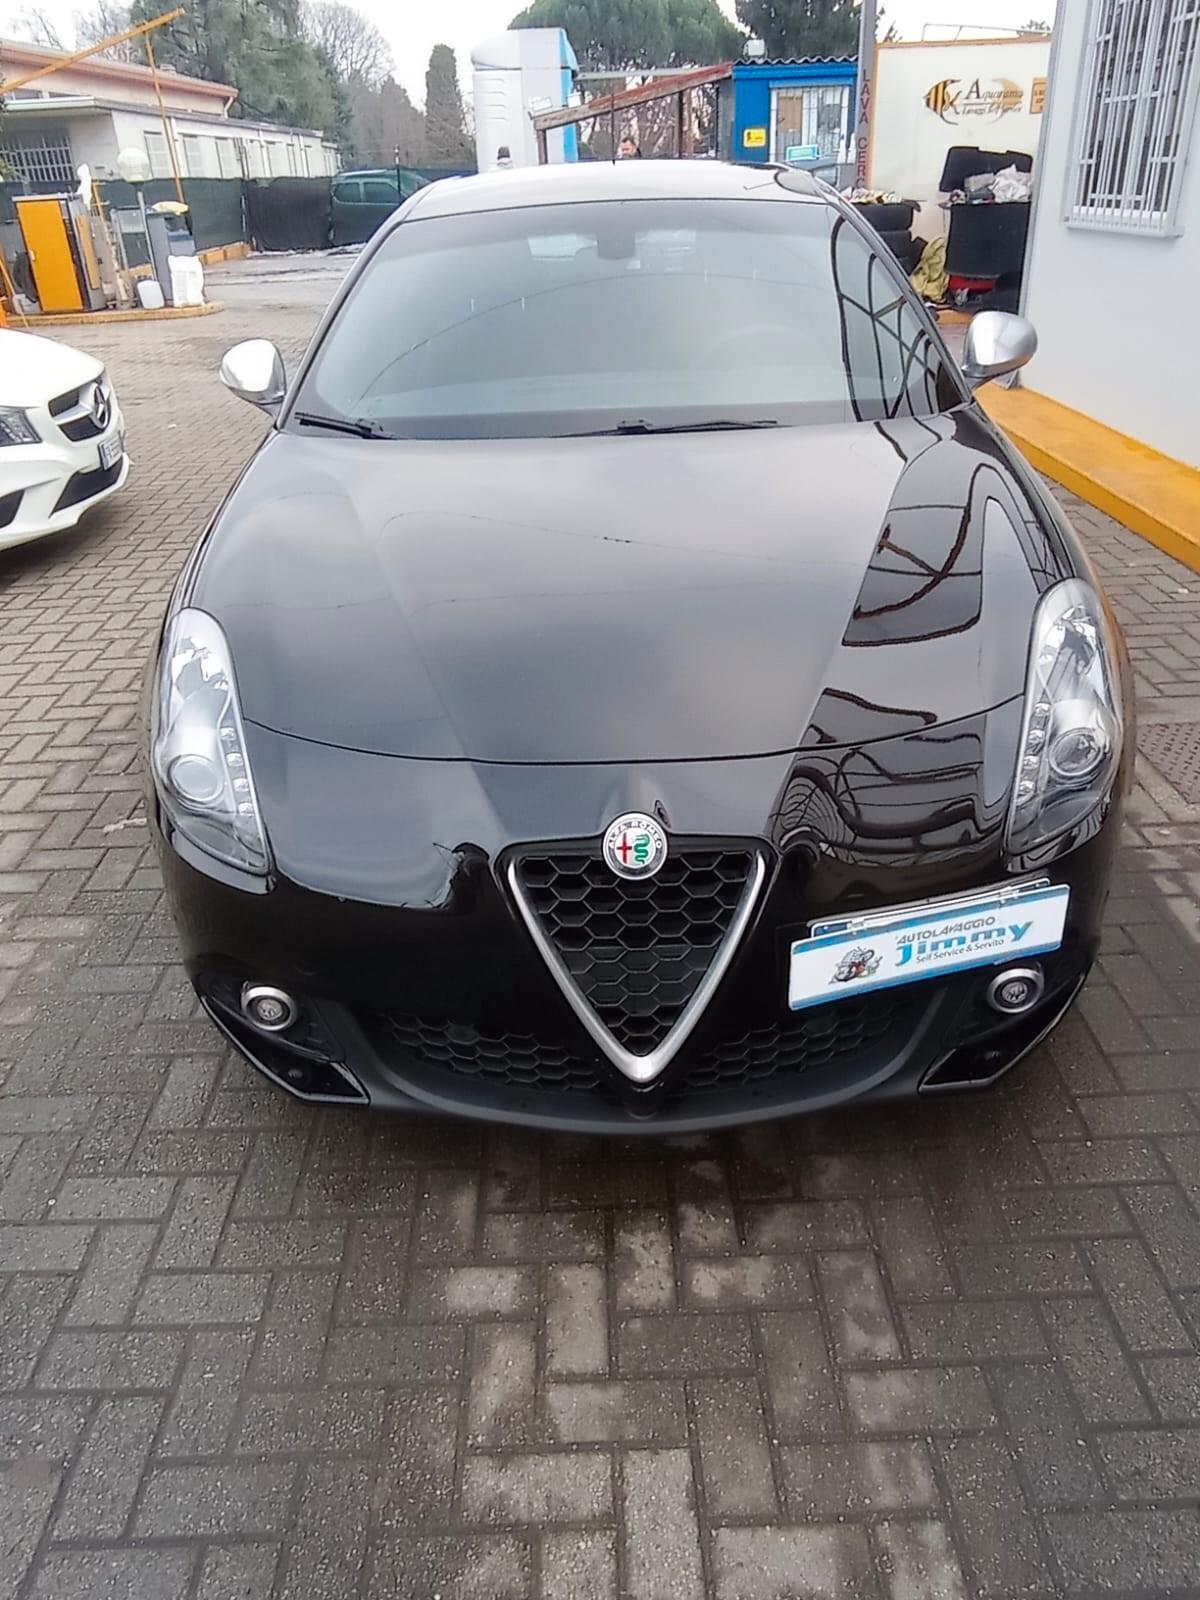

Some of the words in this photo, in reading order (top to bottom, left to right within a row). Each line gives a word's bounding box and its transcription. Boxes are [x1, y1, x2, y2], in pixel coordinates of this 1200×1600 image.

[860, 69, 870, 124] LAVA
[896, 916, 995, 945] AUTOLAVAGGIO
[916, 954, 931, 963] Self
[934, 945, 964, 960] Service
[966, 944, 973, 952] &
[976, 938, 1004, 950] Servito
